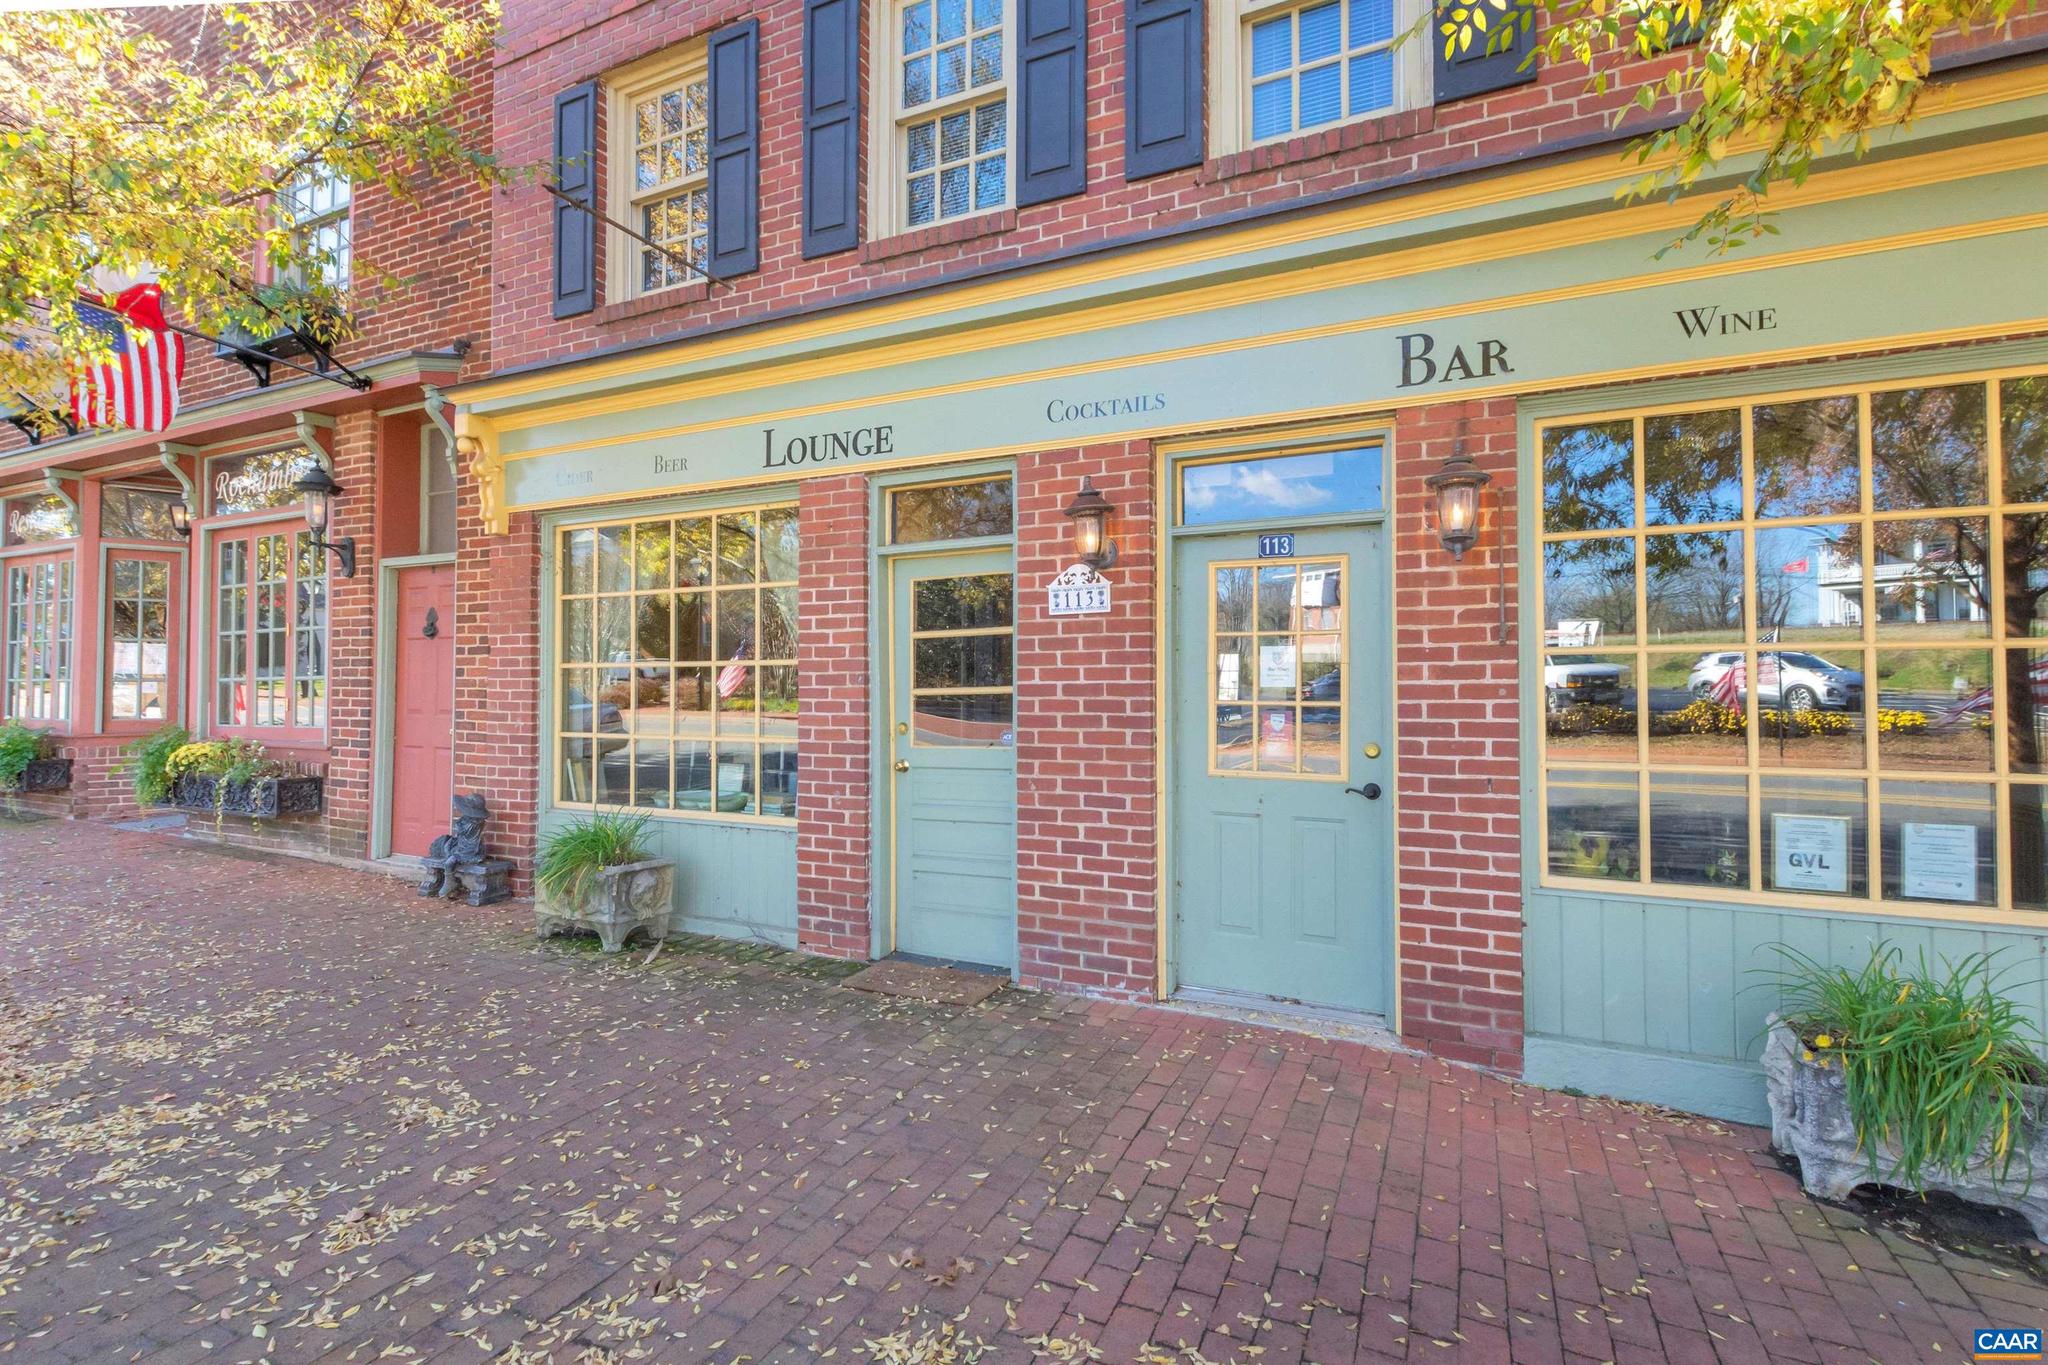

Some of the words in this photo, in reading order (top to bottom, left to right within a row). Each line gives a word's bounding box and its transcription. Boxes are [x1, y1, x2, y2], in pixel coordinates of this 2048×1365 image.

[1672, 305, 1777, 339] WINE
[1395, 333, 1515, 388] BAR
[1046, 392, 1166, 423] COCKTAILS
[762, 425, 893, 468] LOUNGE
[654, 454, 688, 474] BEER
[1263, 537, 1290, 555] 113
[1064, 590, 1093, 608] 113
[1789, 852, 1830, 870] GVL
